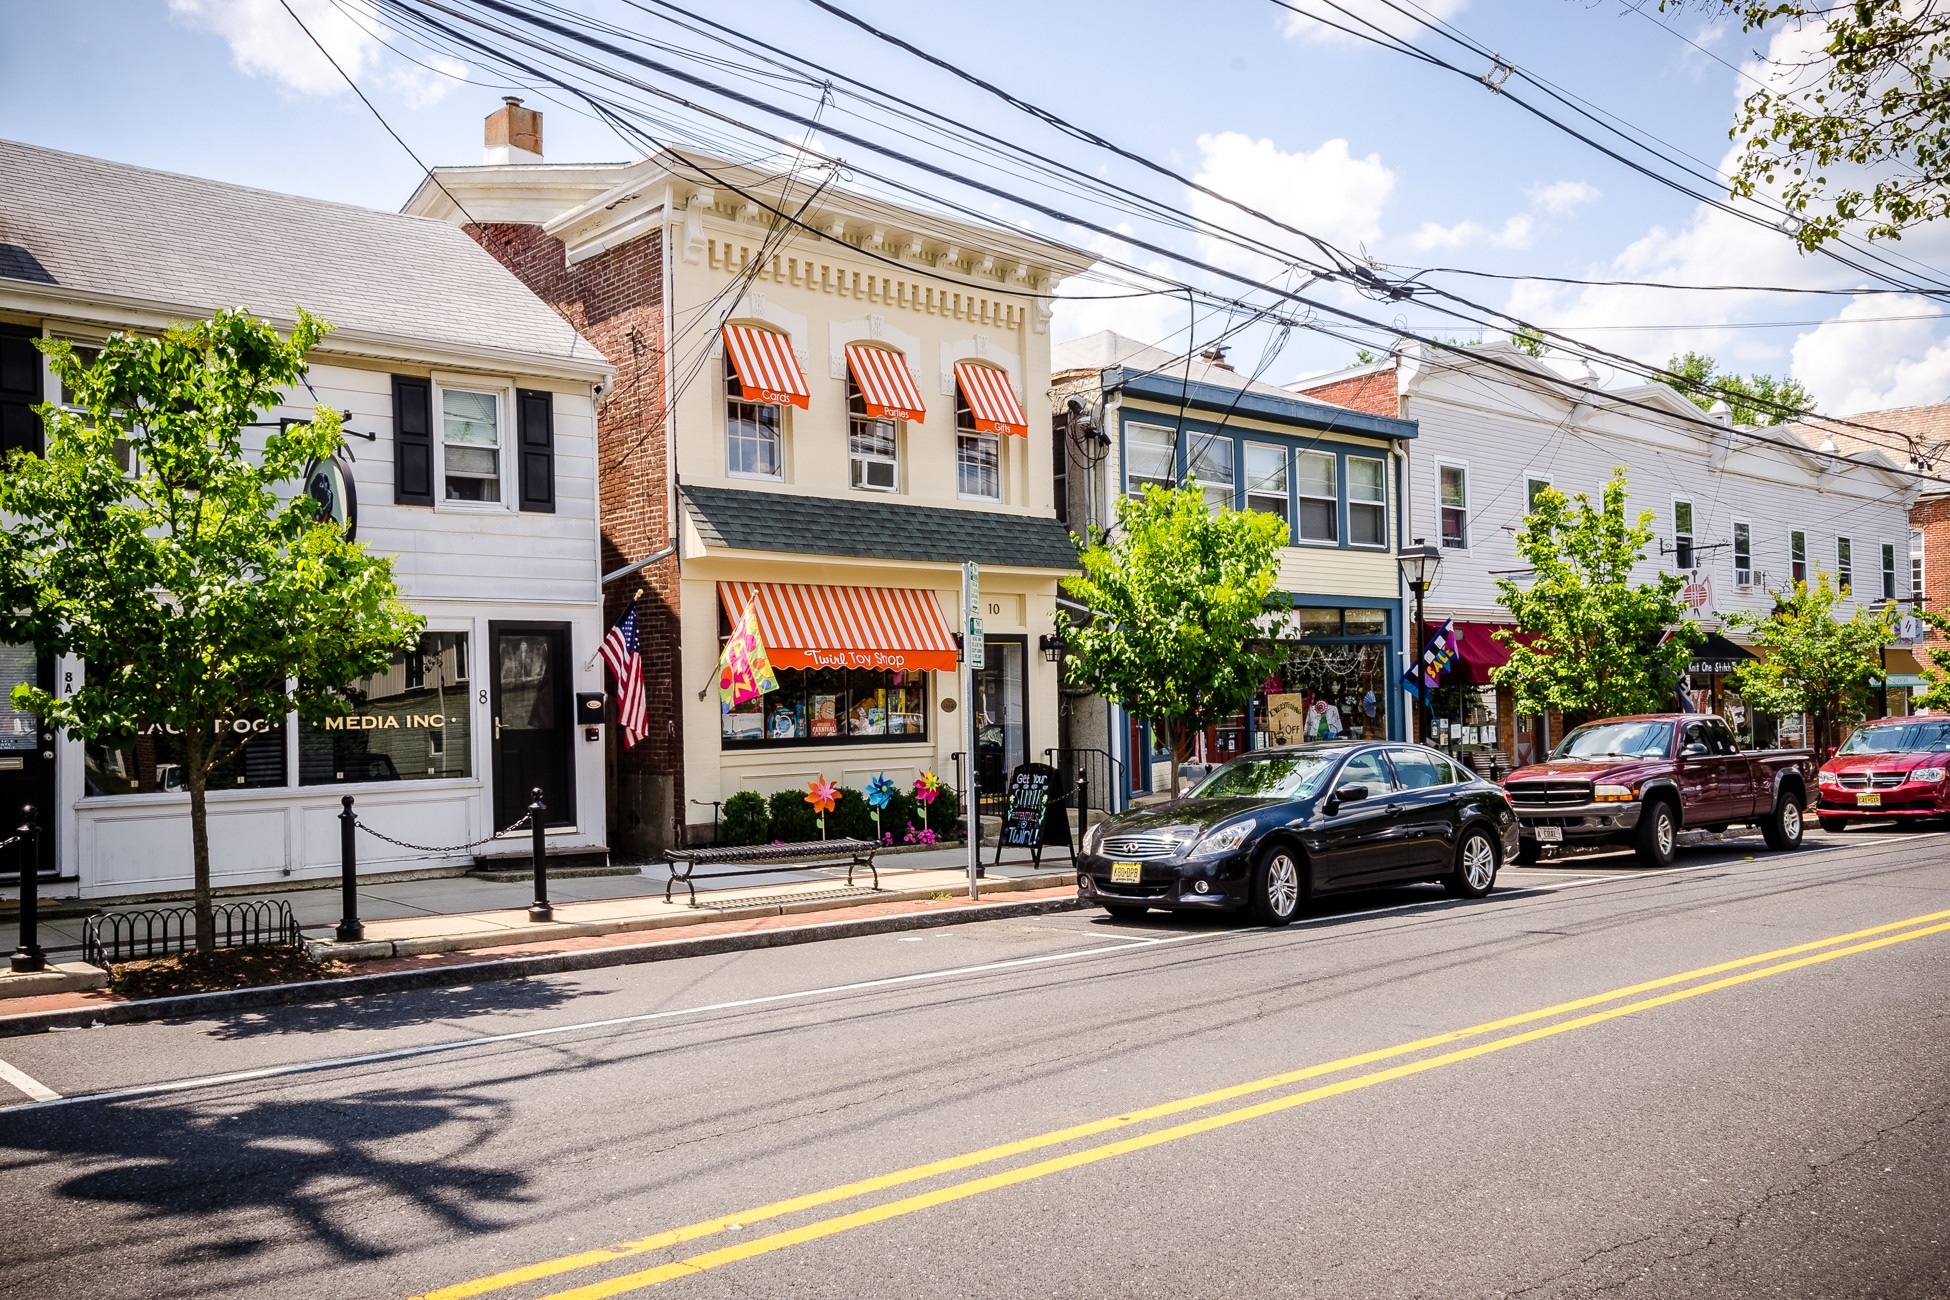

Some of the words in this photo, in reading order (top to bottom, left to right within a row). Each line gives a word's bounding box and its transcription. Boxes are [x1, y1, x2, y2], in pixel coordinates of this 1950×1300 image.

[762, 390, 791, 403] Cards
[884, 407, 910, 419] Parties
[994, 422, 1011, 433] Gifts
[988, 603, 1000, 615] 10
[804, 649, 848, 665] Twirl
[848, 651, 871, 666] Toy
[874, 652, 905, 668] Shop
[1688, 661, 1700, 672] Knit
[1701, 661, 1713, 672] One
[1714, 661, 1732, 673] Stitch
[479, 689, 488, 704] 8
[325, 715, 400, 730] MEDIA
[406, 714, 445, 728] INC
[1285, 724, 1300, 735] OFF
[1016, 773, 1030, 784] Get
[1033, 774, 1048, 784] Your
